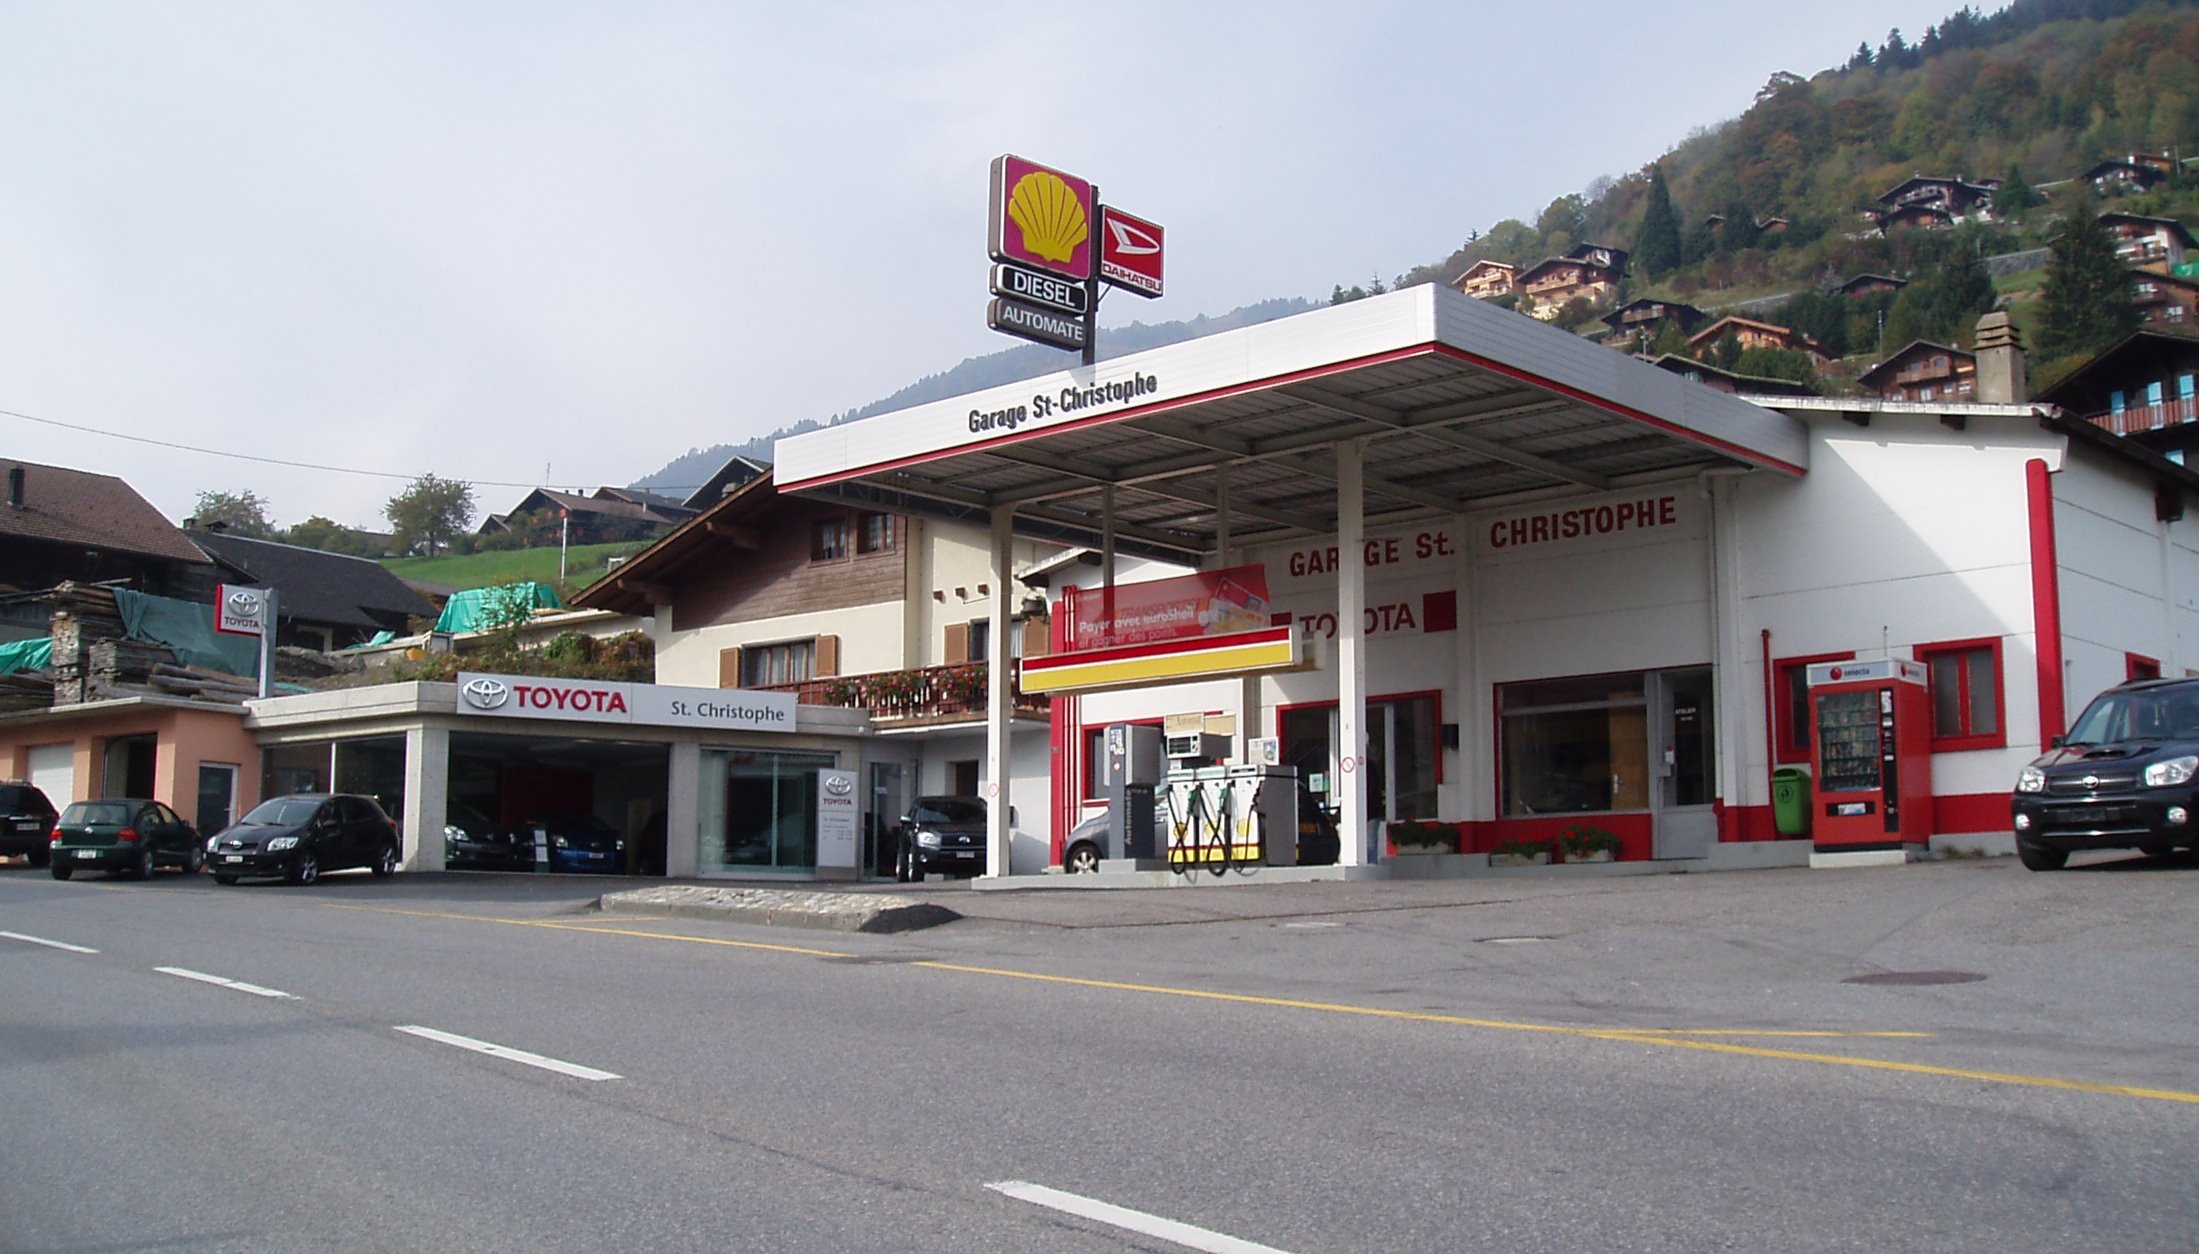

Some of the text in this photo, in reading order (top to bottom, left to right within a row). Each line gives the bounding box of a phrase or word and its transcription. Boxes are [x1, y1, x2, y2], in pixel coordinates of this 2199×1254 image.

[1013, 272, 1075, 307] DIESEL
[1102, 263, 1162, 292] DAIHATSU
[1003, 305, 1084, 341] AUTOMATE
[968, 372, 1158, 433] Garage St-Christophe
[1290, 496, 1677, 577] GARGE St. CHRISTOPHE
[224, 616, 260, 629] TOYOTA
[1114, 616, 1141, 629] avec
[1299, 603, 1415, 639] TOOTA
[513, 685, 785, 724] TOYOTA St. Christophe
[823, 798, 852, 806] TOYOTA
